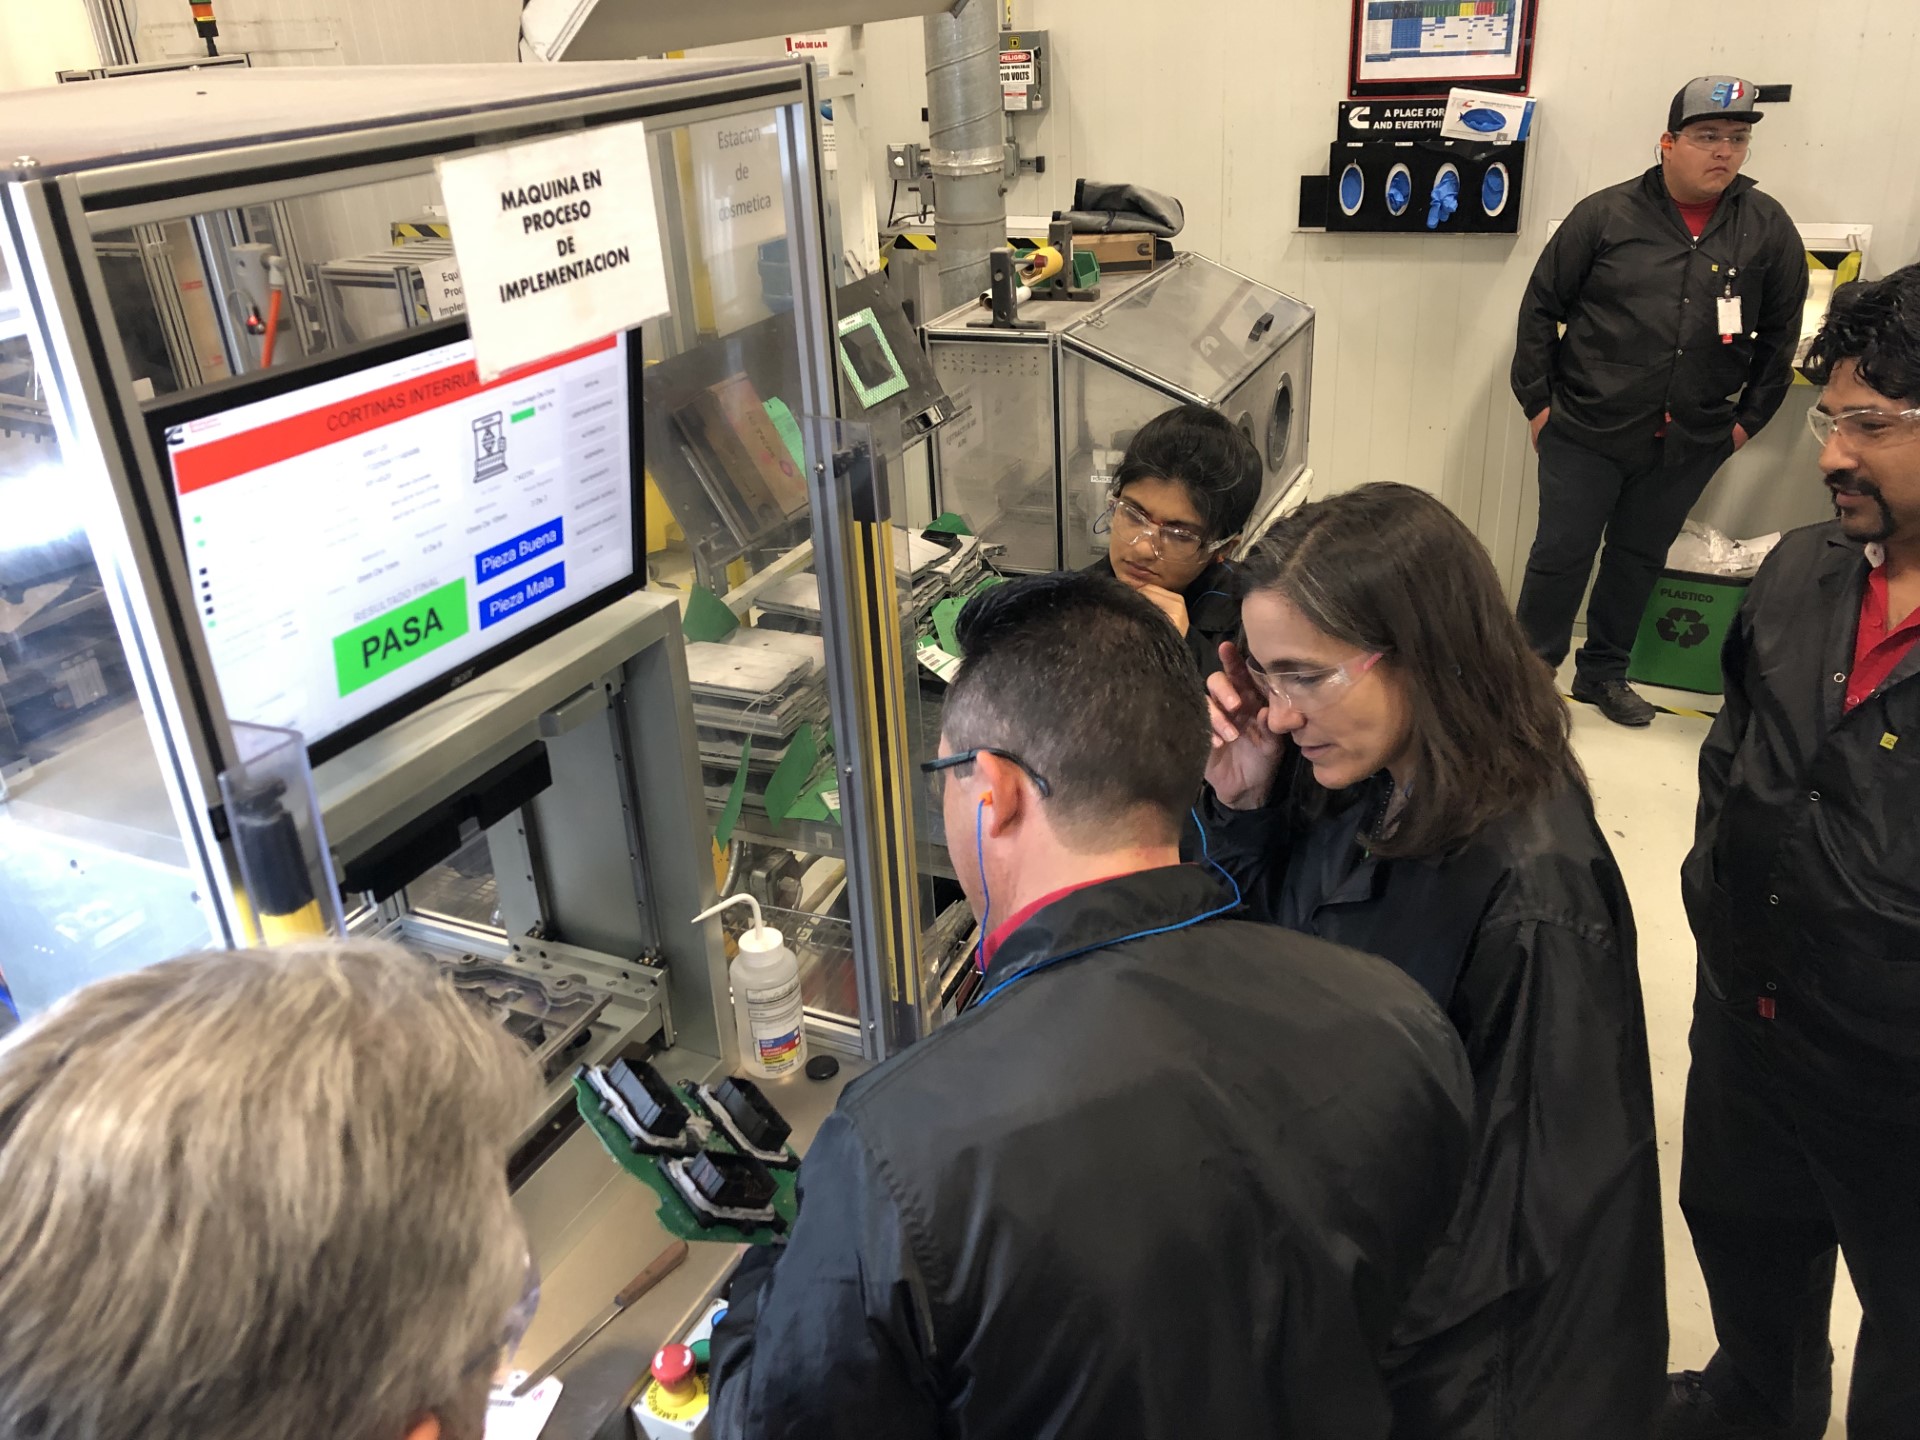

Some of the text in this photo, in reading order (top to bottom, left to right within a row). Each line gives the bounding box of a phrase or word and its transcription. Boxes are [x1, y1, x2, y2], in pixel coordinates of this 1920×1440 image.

[1001, 53, 1026, 61] PELIGRO
[1011, 71, 1029, 81] VOLTS
[1373, 120, 1393, 129] AND
[1384, 107, 1445, 118] A PLACE FOR
[717, 126, 761, 150] Estacion
[735, 161, 750, 181] de
[500, 168, 603, 211] MAQUINA EN
[522, 200, 592, 234] PROCESO
[718, 193, 772, 222] cosmetica
[556, 235, 576, 257] DE
[499, 246, 631, 303] IMPLEMENTACION
[326, 392, 407, 432] CORTINAS
[481, 528, 557, 574] Pieza Buena
[489, 574, 555, 618] Pieza Mala
[1660, 588, 1714, 603] PLASTICO
[361, 606, 443, 669] PASA
